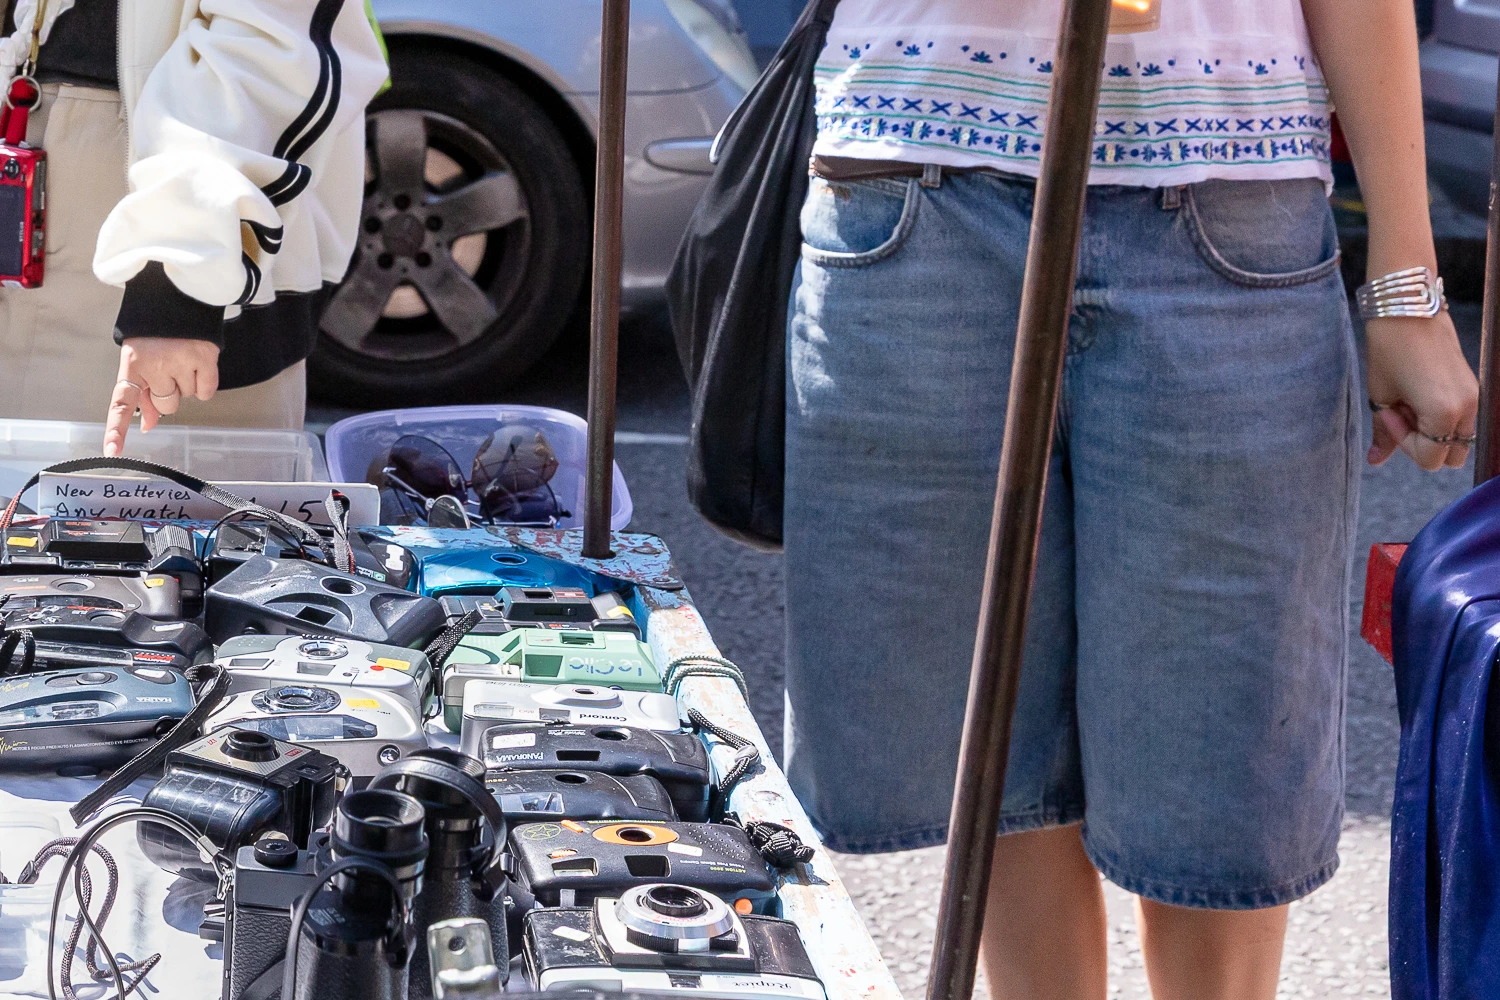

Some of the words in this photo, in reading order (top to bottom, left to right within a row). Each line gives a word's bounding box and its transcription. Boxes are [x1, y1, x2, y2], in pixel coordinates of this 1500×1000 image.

[55, 484, 92, 499] New
[102, 483, 191, 500] Batteries
[55, 502, 107, 520] Any
[569, 656, 615, 675] Clic
[618, 659, 642, 676] Le
[579, 713, 627, 723] Concord
[496, 751, 543, 762] PANORAMA
[734, 980, 792, 990] Rapier
